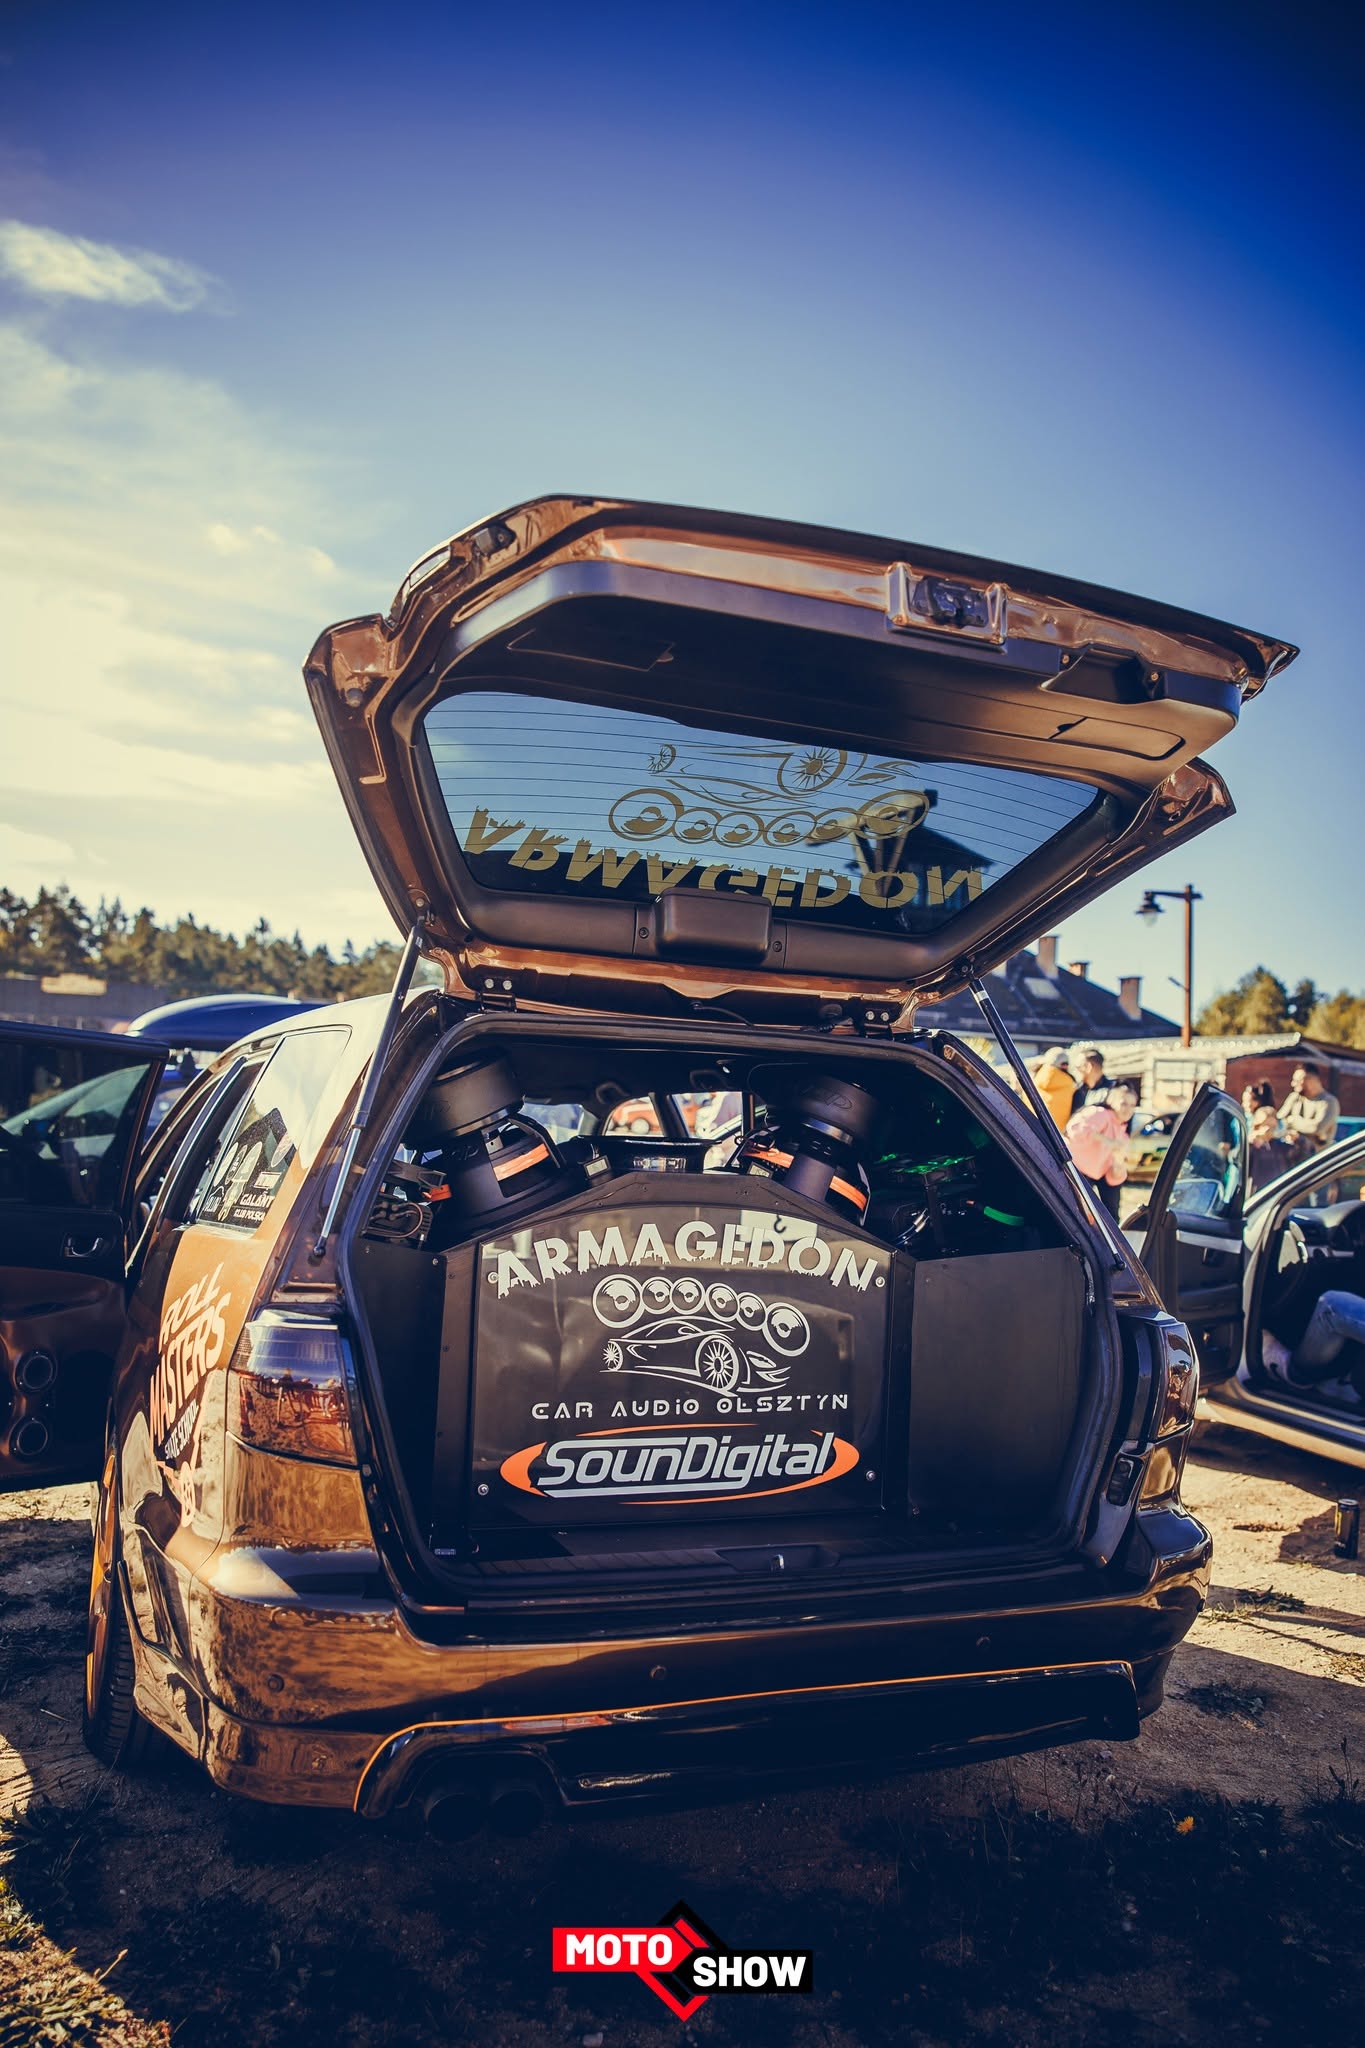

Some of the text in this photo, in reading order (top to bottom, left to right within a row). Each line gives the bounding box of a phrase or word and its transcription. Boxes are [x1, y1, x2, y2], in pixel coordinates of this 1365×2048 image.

[240, 1194, 275, 1207] GALANT
[497, 1220, 878, 1299] ARMAGEDON
[158, 1262, 224, 1353] ROLL
[150, 1293, 231, 1446] MASTERS
[531, 1401, 594, 1420] CAR
[716, 1393, 849, 1415] OLSZTYN
